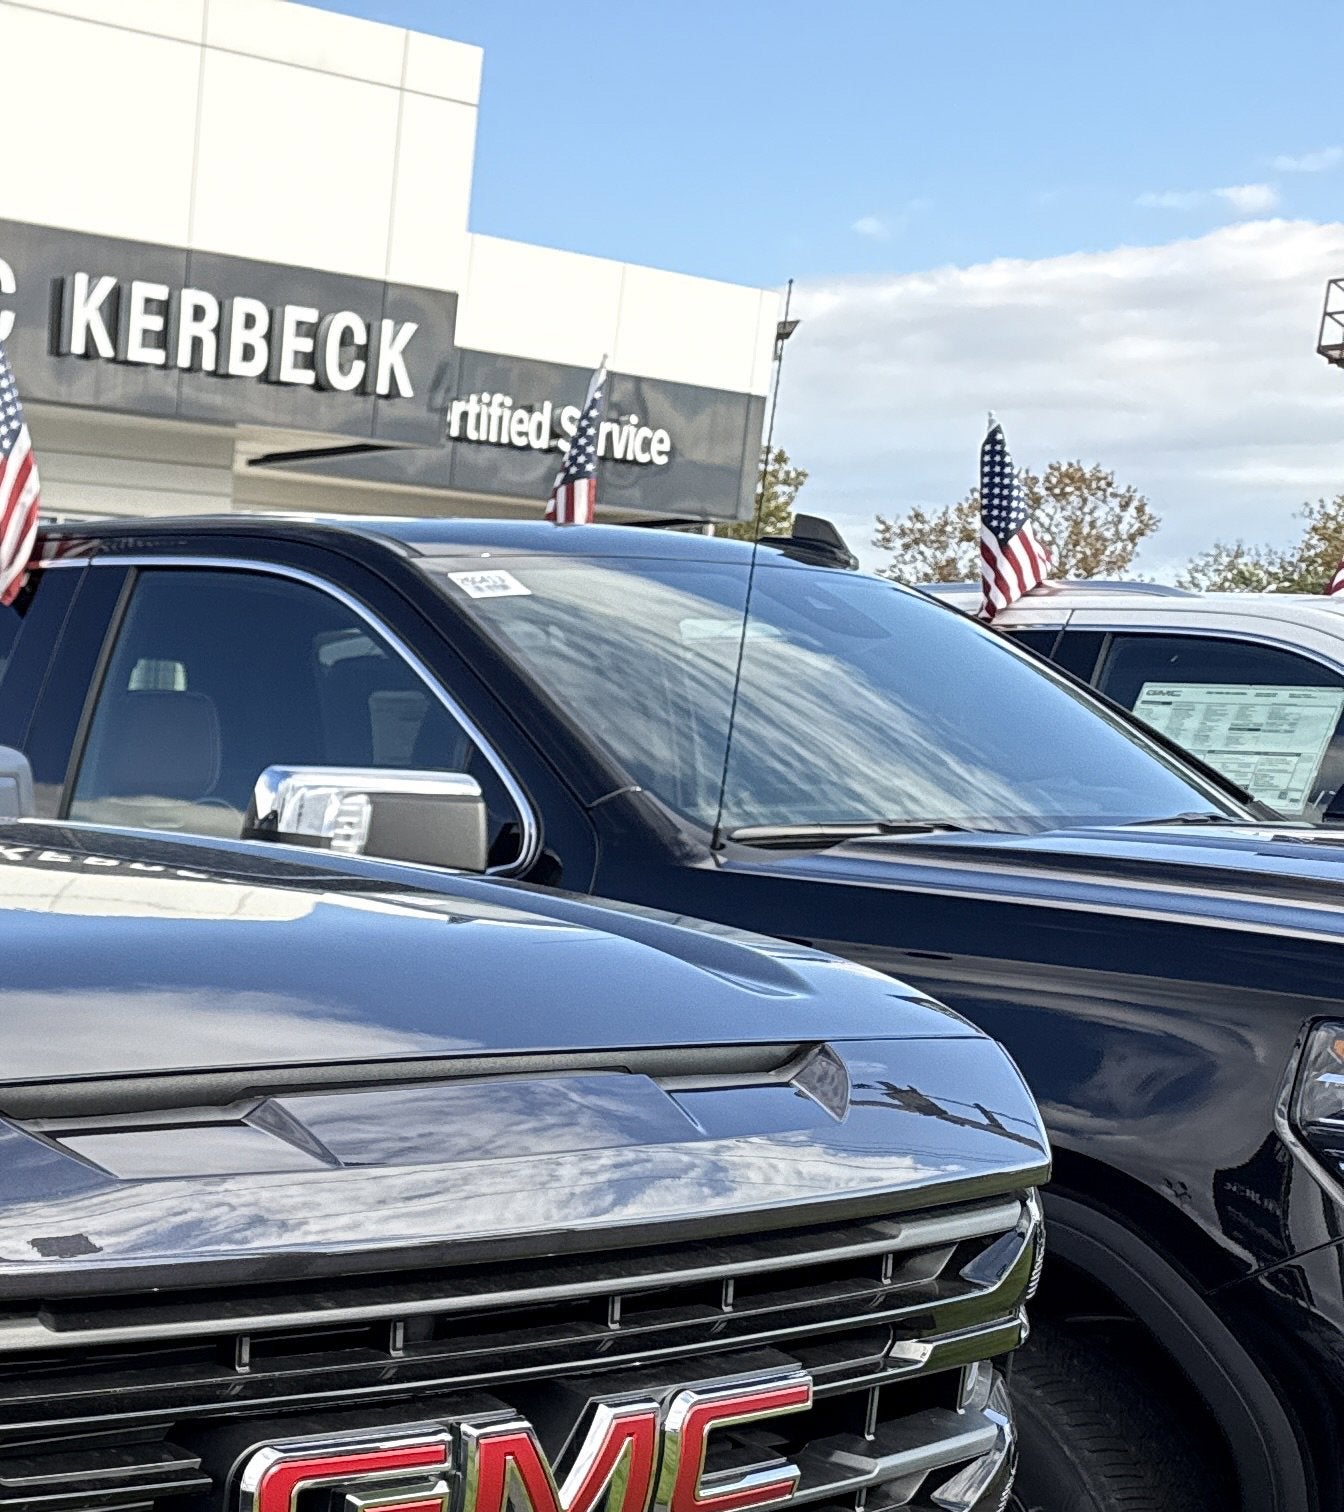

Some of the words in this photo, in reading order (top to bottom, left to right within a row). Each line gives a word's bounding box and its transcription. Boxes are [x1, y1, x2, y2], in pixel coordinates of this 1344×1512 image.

[70, 271, 419, 398] KERBECK
[447, 392, 552, 449] rtified
[558, 404, 671, 465] Srvice
